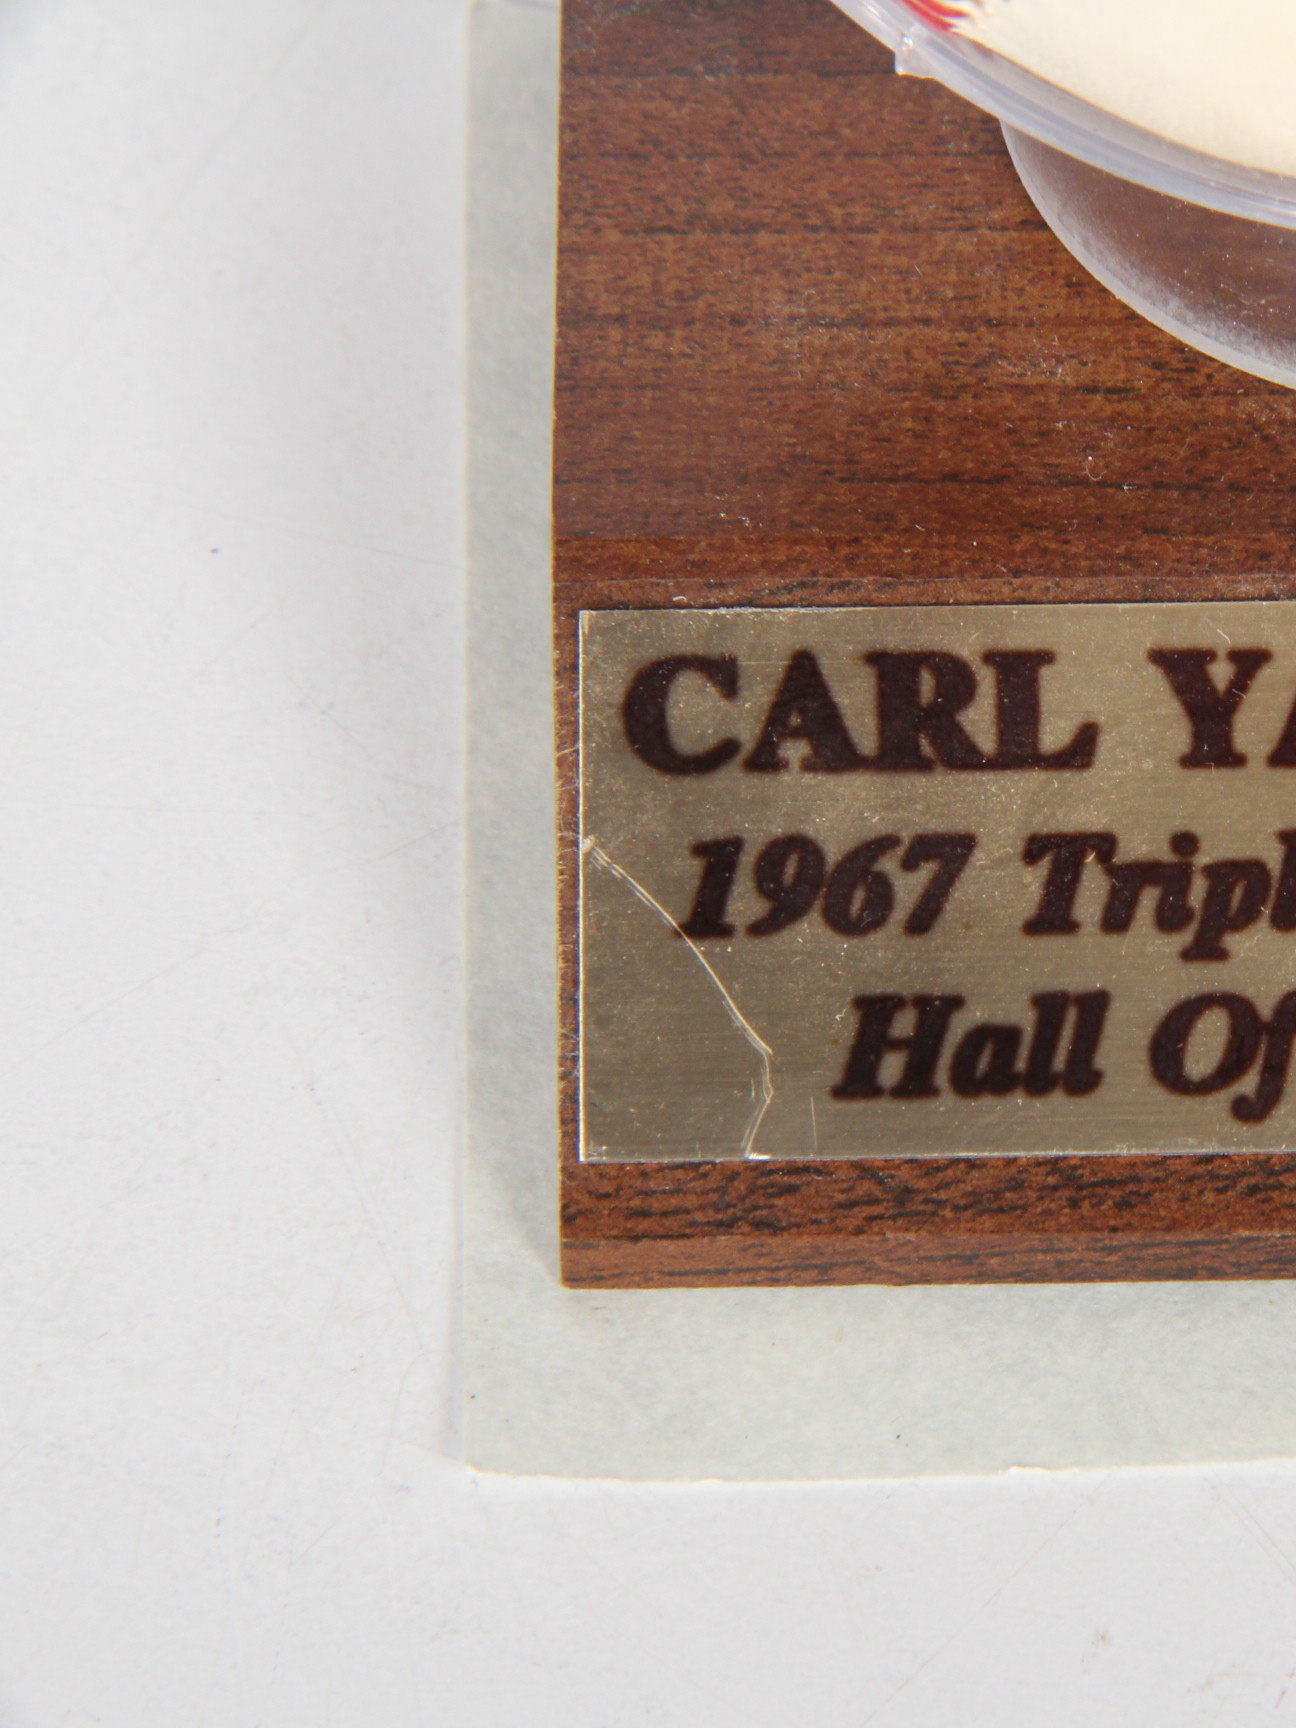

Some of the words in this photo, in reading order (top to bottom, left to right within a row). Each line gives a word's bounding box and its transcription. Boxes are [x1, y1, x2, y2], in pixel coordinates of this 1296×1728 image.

[622, 649, 1097, 776] CARL
[681, 833, 977, 940] 1967
[831, 990, 1111, 1100] Hall
